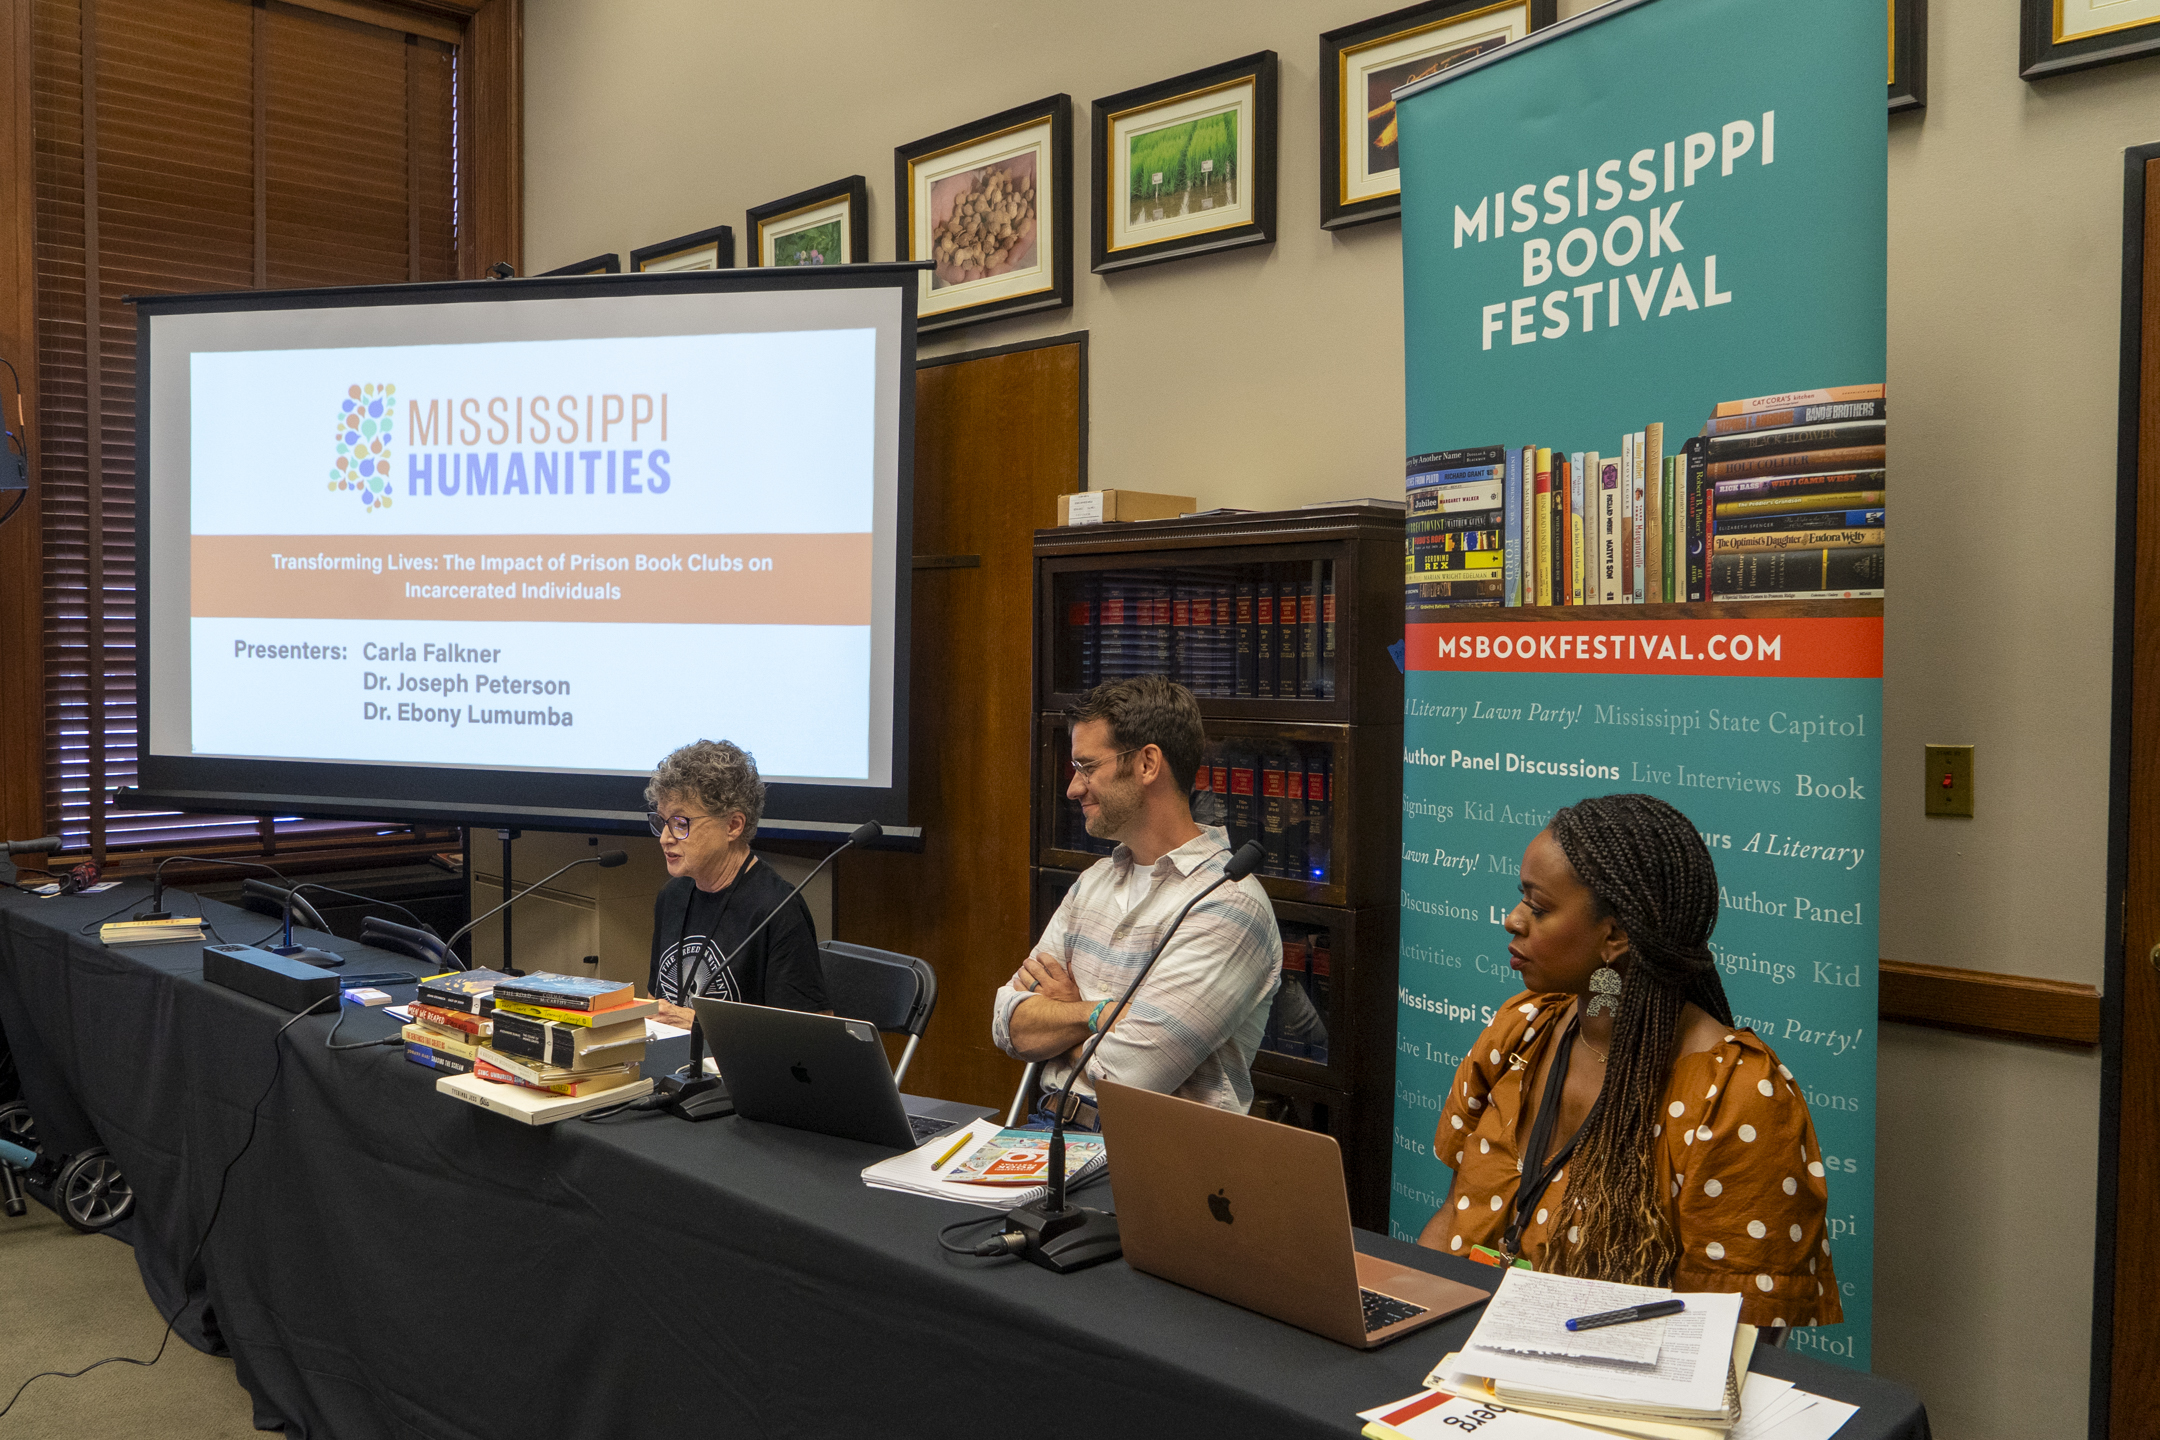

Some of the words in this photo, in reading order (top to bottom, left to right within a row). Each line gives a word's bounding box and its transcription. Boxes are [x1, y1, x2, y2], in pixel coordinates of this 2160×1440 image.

[1453, 110, 1775, 249] MISSISSIPPI
[1523, 200, 1685, 287] BOOK
[1482, 254, 1732, 351] FESTIVAL
[1752, 399, 1765, 407] CAT
[1766, 395, 1791, 405] CORA'S
[1793, 393, 1815, 401] kitchen
[1805, 405, 1825, 422] BAND
[1833, 402, 1875, 418] BROTHERS
[408, 393, 669, 447] MISSISSIPPI
[1418, 454, 1442, 464] Another
[1443, 452, 1461, 461] Name
[1726, 462, 1753, 474] HOLT
[1757, 455, 1809, 470] COLLIER
[408, 450, 671, 497] HUMANITIES
[1426, 473, 1439, 484] PLUTO
[1444, 472, 1466, 480] RICHARD
[1467, 470, 1485, 478] GRANT
[1719, 484, 1739, 493] RICK
[1740, 482, 1760, 491] BASS
[1771, 479, 1791, 488] WHY
[1799, 477, 1825, 485] CAME
[1826, 474, 1857, 483] WEST
[1415, 500, 1437, 508] Jubilee
[1695, 509, 1703, 537] Parker's
[1716, 536, 1729, 548] The
[1730, 535, 1765, 549] Optimist's
[1766, 535, 1801, 549] Daughter
[1809, 532, 1840, 543] Eudora
[1841, 531, 1866, 545] Welty
[271, 553, 383, 575] Transforming
[389, 553, 439, 572] Lives:
[443, 553, 475, 571] The
[480, 554, 540, 576] Impact
[547, 553, 566, 571] of
[571, 553, 629, 572] Prison
[635, 553, 682, 572] Book
[687, 554, 743, 573] Clubs
[748, 557, 773, 572] on
[1424, 562, 1449, 570] REX
[1505, 539, 1513, 580] FORD
[405, 581, 516, 600] Incarcerated
[522, 581, 621, 601] Individuals
[234, 640, 347, 661] Presenters:
[363, 642, 416, 663] Carla
[422, 642, 501, 664] Falkner
[1438, 634, 1782, 661] MSBOOKFESTIVAL.COM
[363, 672, 391, 691] Dr.
[397, 672, 469, 697] Joseph
[475, 674, 571, 696] Peterson
[363, 702, 392, 722] Dr.
[398, 702, 462, 728] Ebony
[467, 704, 574, 727] Lumumba
[1411, 699, 1467, 724] Literary
[1472, 701, 1521, 720] Lawn
[1528, 702, 1582, 729] Party!
[1595, 704, 1701, 735] Mississippi
[1709, 709, 1760, 733] State
[1769, 711, 1866, 742] Capitol
[1404, 746, 1446, 767] Author
[1451, 750, 1499, 771] Panel
[1506, 753, 1620, 780] Discussions
[1631, 761, 1671, 786] Live
[1677, 764, 1781, 795] Interviews
[1795, 773, 1866, 800] Book
[1402, 793, 1454, 822] Signings
[1464, 801, 1494, 821] Kid
[1742, 832, 1761, 853] A
[1765, 834, 1864, 870] Literary
[1402, 843, 1429, 864] Lawn
[1433, 848, 1479, 876] Party!
[1719, 886, 1787, 917] Author
[1794, 897, 1863, 925] Panel
[1401, 889, 1478, 921] Discussions
[1707, 942, 1796, 984] Signings
[1812, 961, 1861, 987] Kid
[661, 955, 676, 972] THE
[1399, 985, 1475, 1023] Mississippi
[1400, 937, 1462, 968] Activities
[1783, 1019, 1862, 1055] Party!
[408, 1006, 418, 1016] MEN
[419, 1010, 427, 1019] WE
[427, 1012, 445, 1025] REAPED
[1397, 1032, 1419, 1057] Live
[553, 1084, 569, 1092] USED
[1396, 1080, 1442, 1112] Capitol
[1395, 1126, 1425, 1155] State
